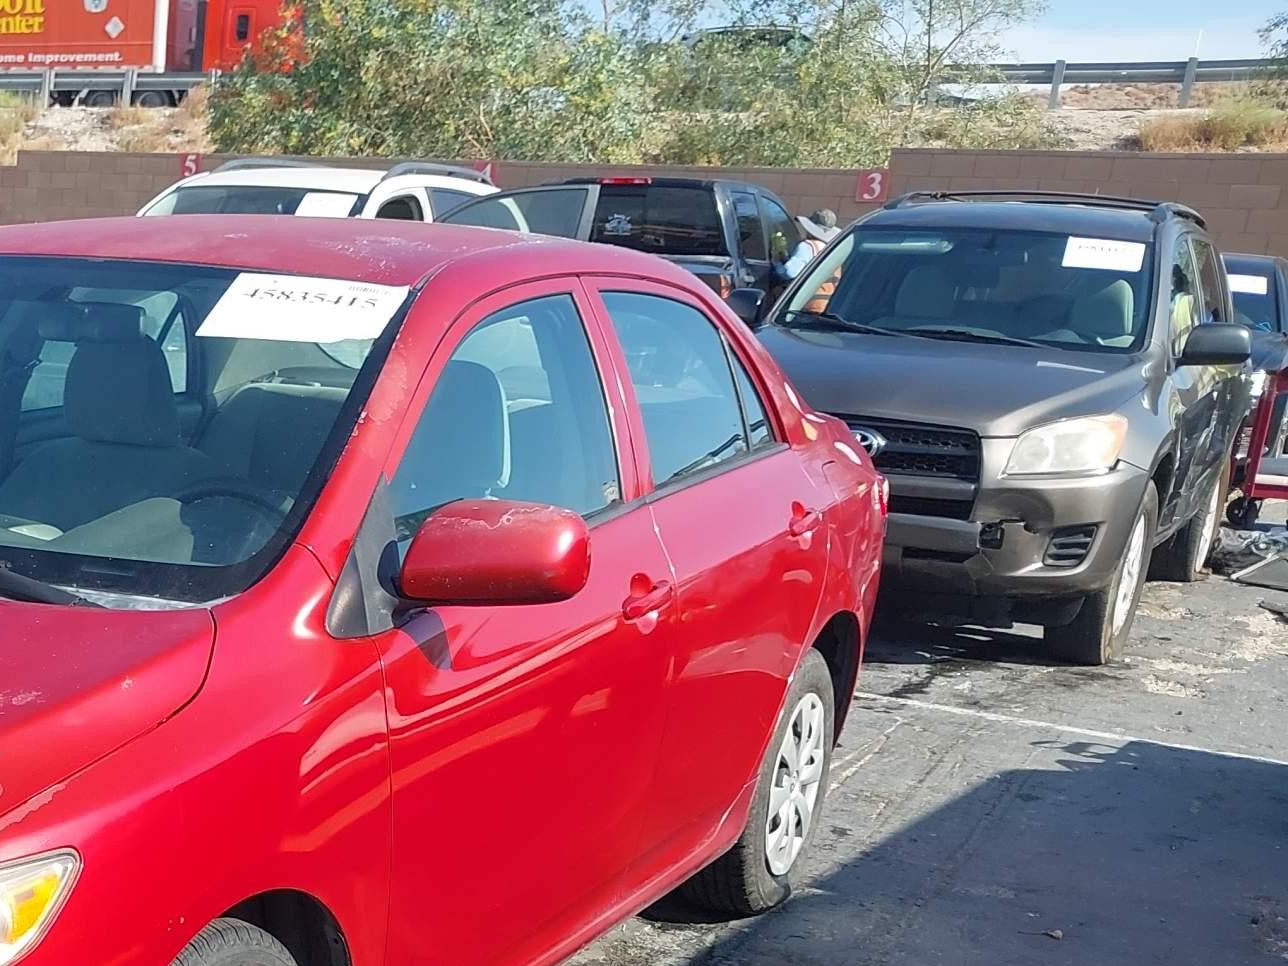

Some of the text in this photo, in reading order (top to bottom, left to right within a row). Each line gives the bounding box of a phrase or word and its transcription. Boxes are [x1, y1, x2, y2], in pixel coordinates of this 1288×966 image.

[28, 51, 123, 64] Improvement.
[184, 154, 197, 177] 5
[863, 172, 882, 199] 3
